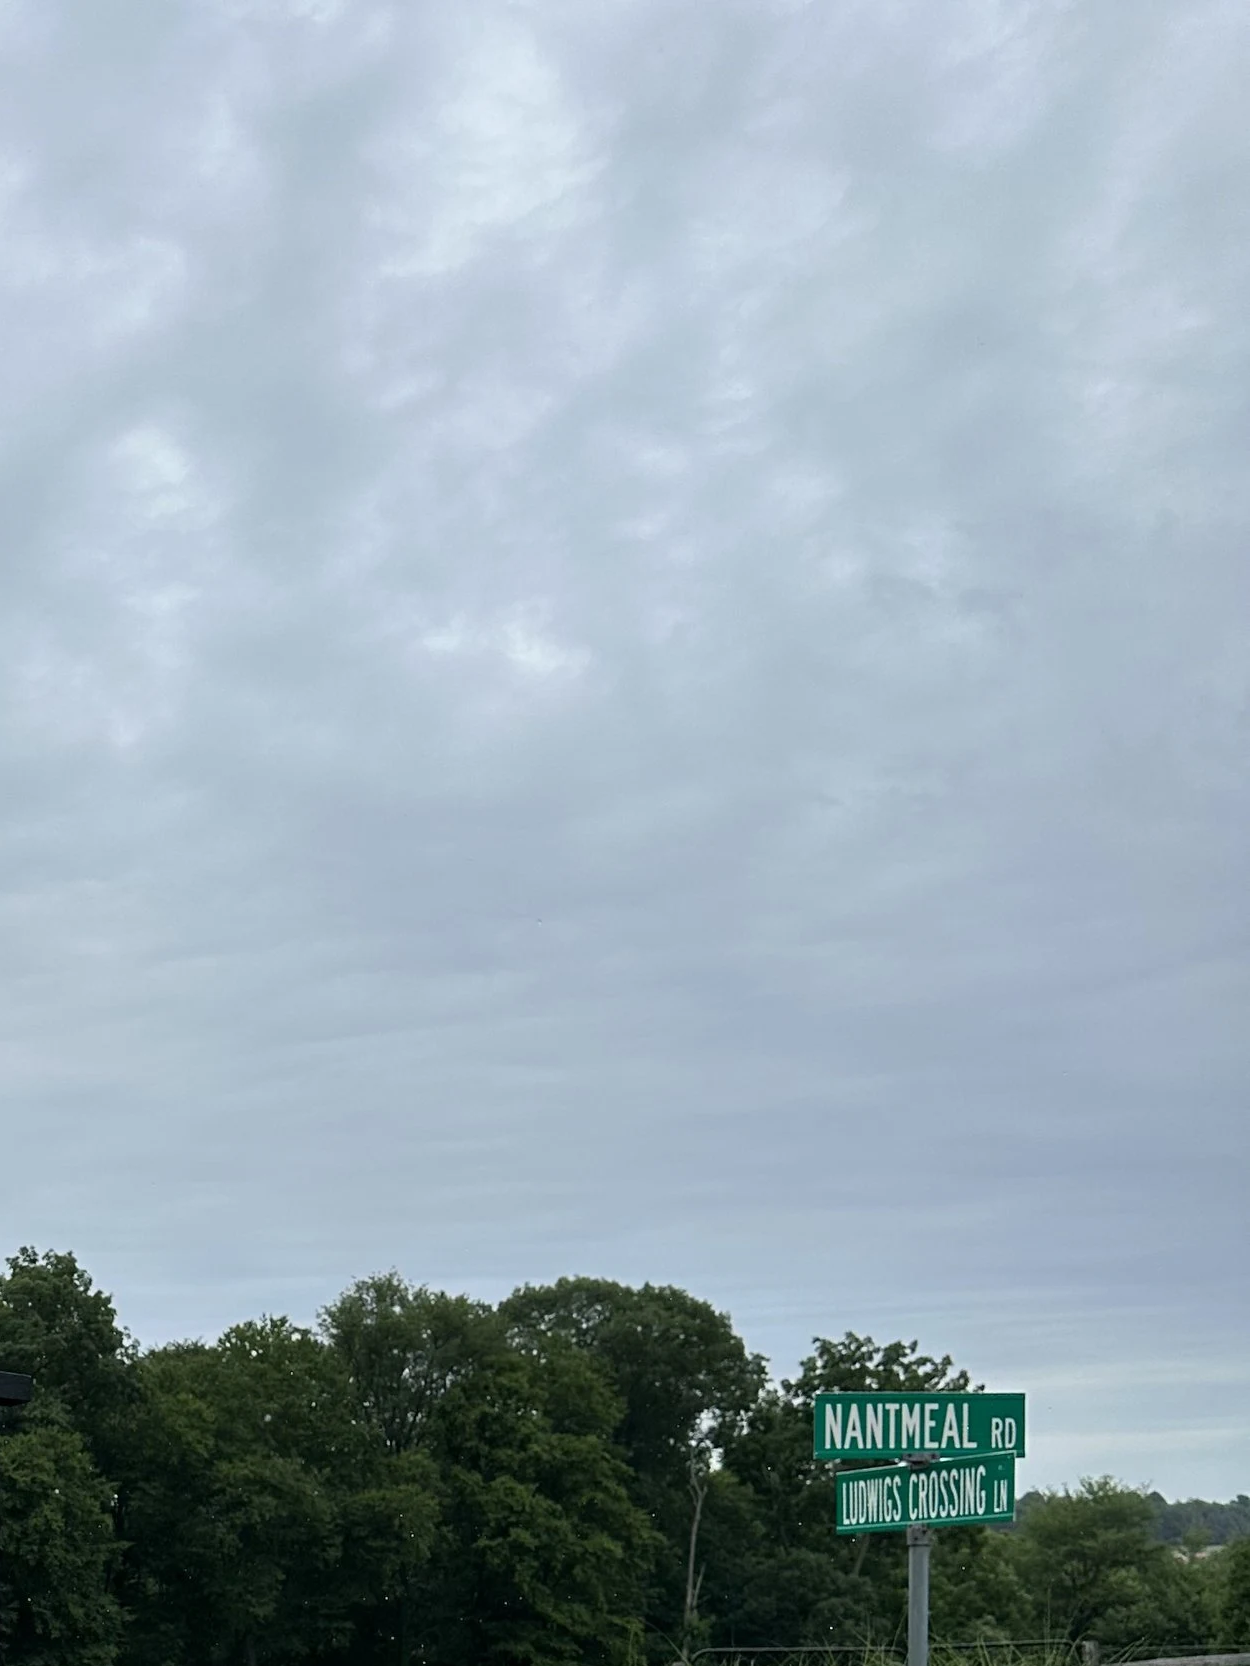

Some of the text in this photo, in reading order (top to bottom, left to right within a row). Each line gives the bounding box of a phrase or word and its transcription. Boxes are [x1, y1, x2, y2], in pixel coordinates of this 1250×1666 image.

[824, 1403, 1017, 1449] NANTMEAL RD
[842, 1465, 1008, 1525] LUDWIGS CROSSING LN
